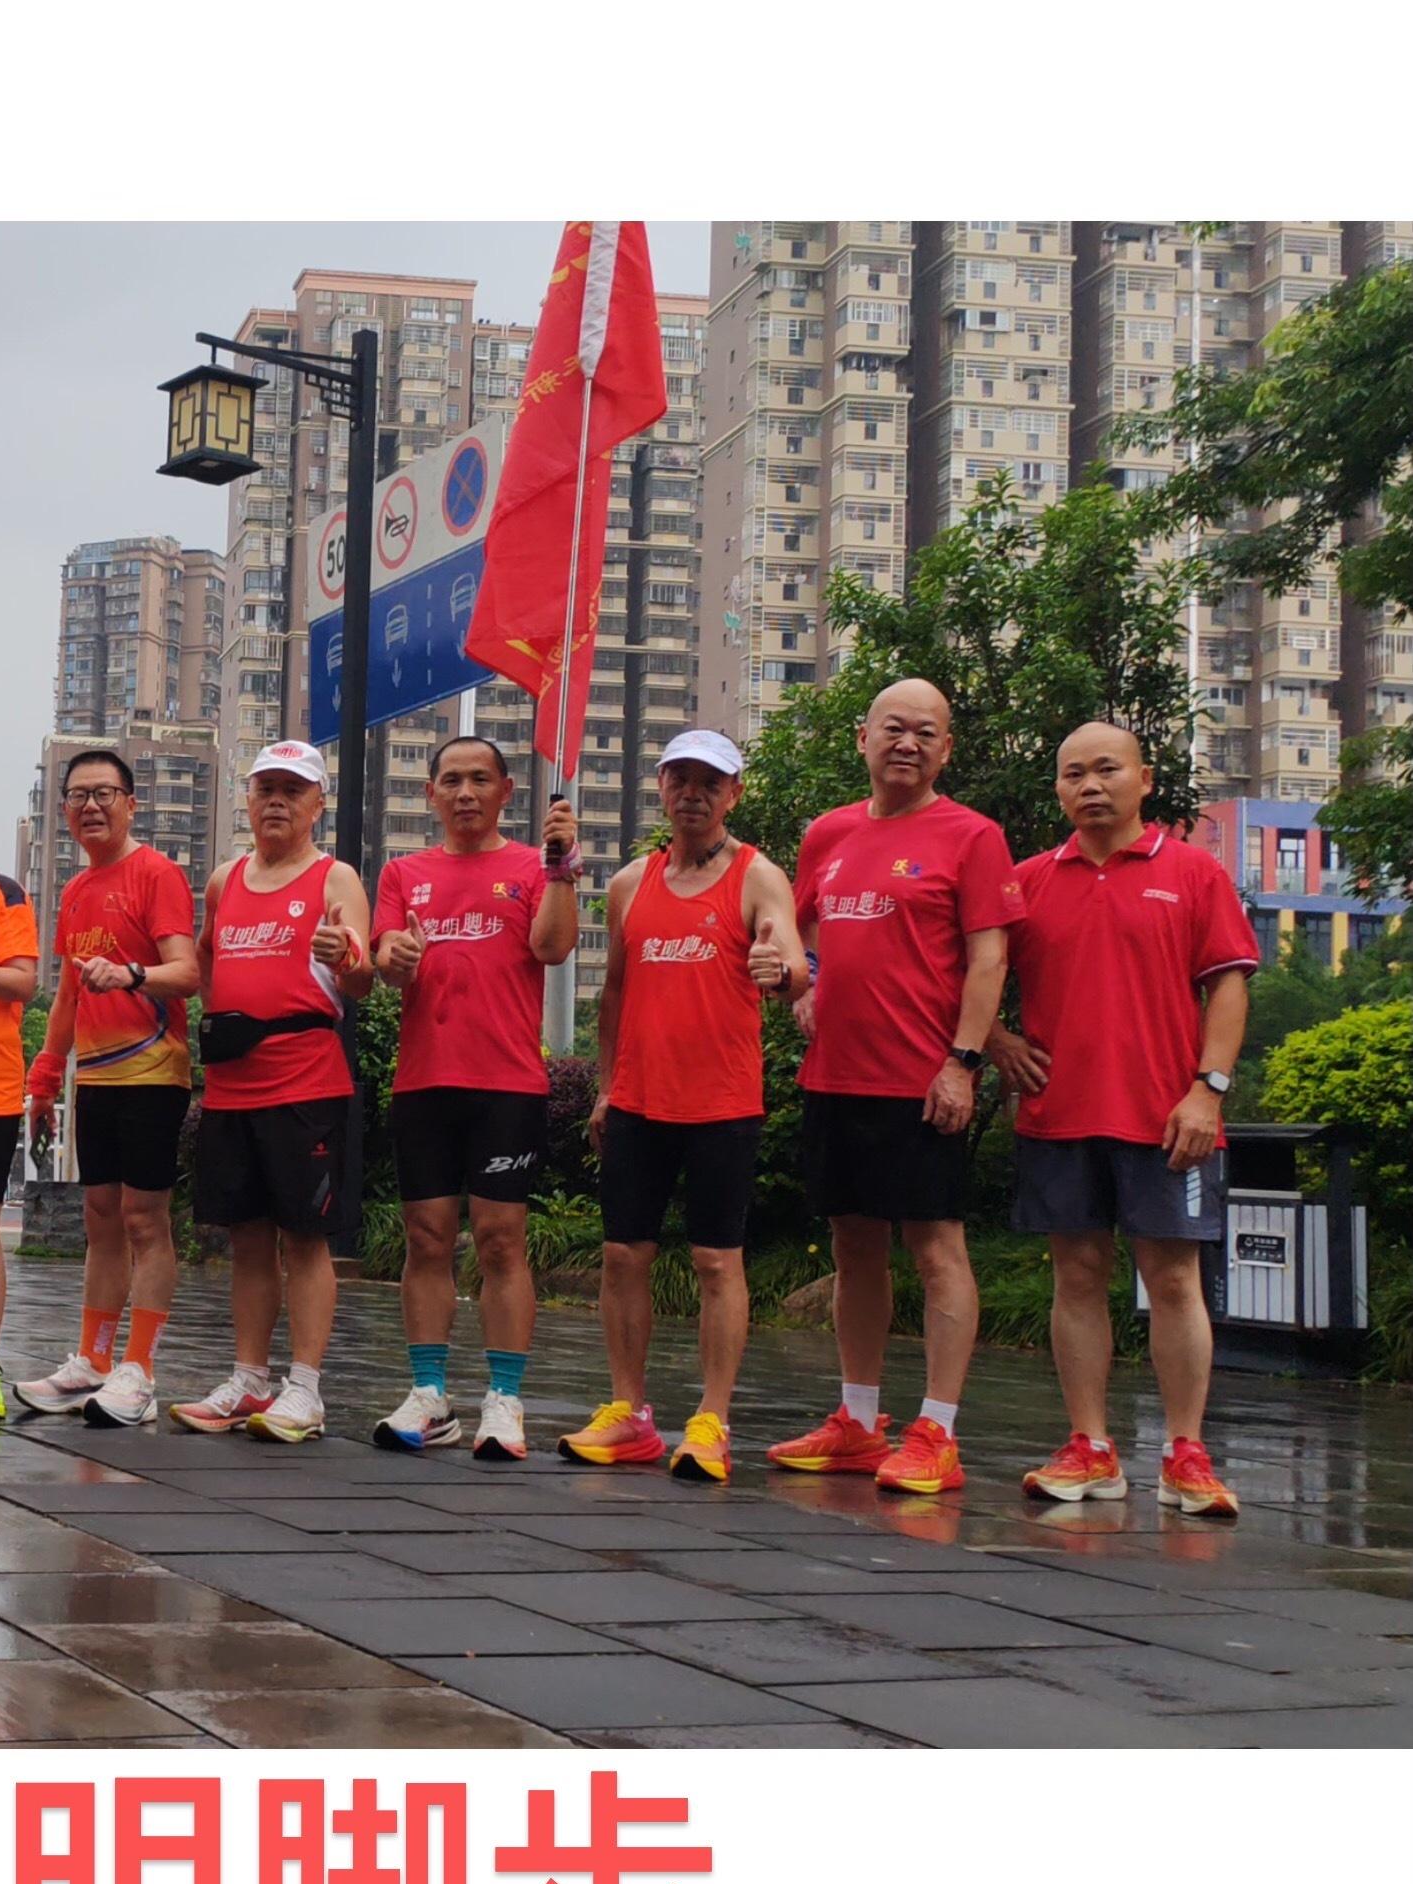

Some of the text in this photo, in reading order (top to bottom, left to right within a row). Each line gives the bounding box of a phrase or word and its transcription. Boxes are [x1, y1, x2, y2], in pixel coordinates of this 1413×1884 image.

[327, 534, 347, 579] 50
[818, 891, 896, 920] 黎明脚步
[218, 921, 296, 949] 黎明脚步
[422, 911, 505, 938] 黎明脚步
[641, 935, 718, 961] 黎明脚步
[482, 1152, 538, 1174] BM
